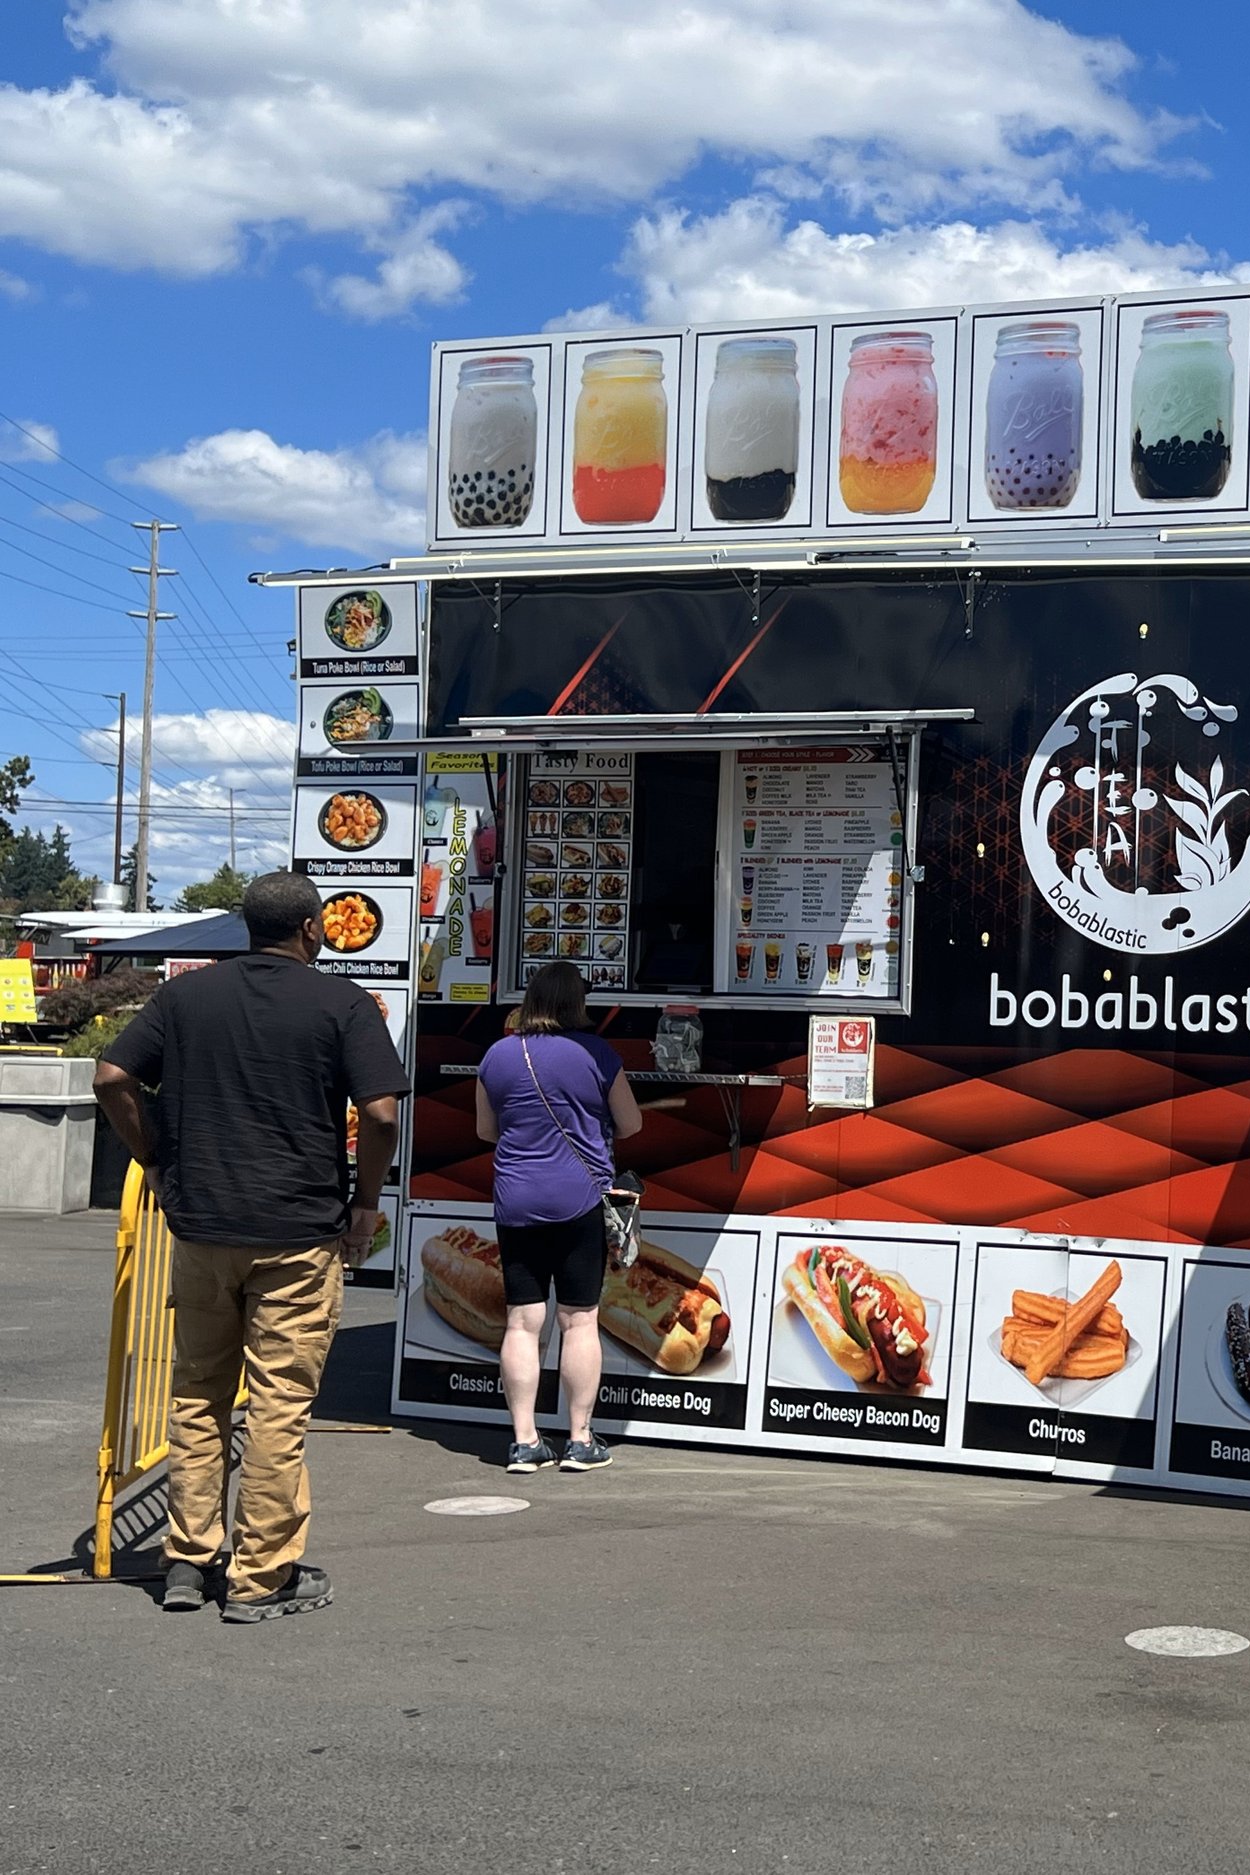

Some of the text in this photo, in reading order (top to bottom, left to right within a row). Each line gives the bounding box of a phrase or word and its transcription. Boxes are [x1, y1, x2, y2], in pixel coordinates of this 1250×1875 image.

[329, 661, 343, 673] Poke
[344, 660, 359, 674] Bowl
[360, 660, 377, 675] (Rice
[377, 662, 384, 672] or
[385, 659, 405, 674] Salad)
[312, 760, 325, 772] Tofu
[326, 760, 341, 772] Poke
[342, 760, 357, 772] Bowl
[375, 762, 383, 772] or
[383, 759, 403, 774] Salad)
[533, 752, 629, 773] Tasty Food
[1101, 719, 1134, 869] TEA
[307, 861, 400, 876] Crispy Orange Chicken Rice Bowl
[449, 796, 468, 957] LEMONADE
[1048, 880, 1147, 949] bobablastic
[333, 961, 346, 974] Chili
[347, 961, 369, 975] Chicken
[370, 962, 383, 975] Rice
[384, 962, 399, 975] Bowl
[816, 1024, 836, 1032] JOIN
[817, 1035, 834, 1043] OUR
[815, 1046, 837, 1054] TEAM
[449, 1374, 494, 1395] Classic
[599, 1385, 712, 1416] Chili Cheese Dog
[769, 1398, 941, 1434] Super Cheesy Bacon Dog
[1029, 1418, 1087, 1444] Churros
